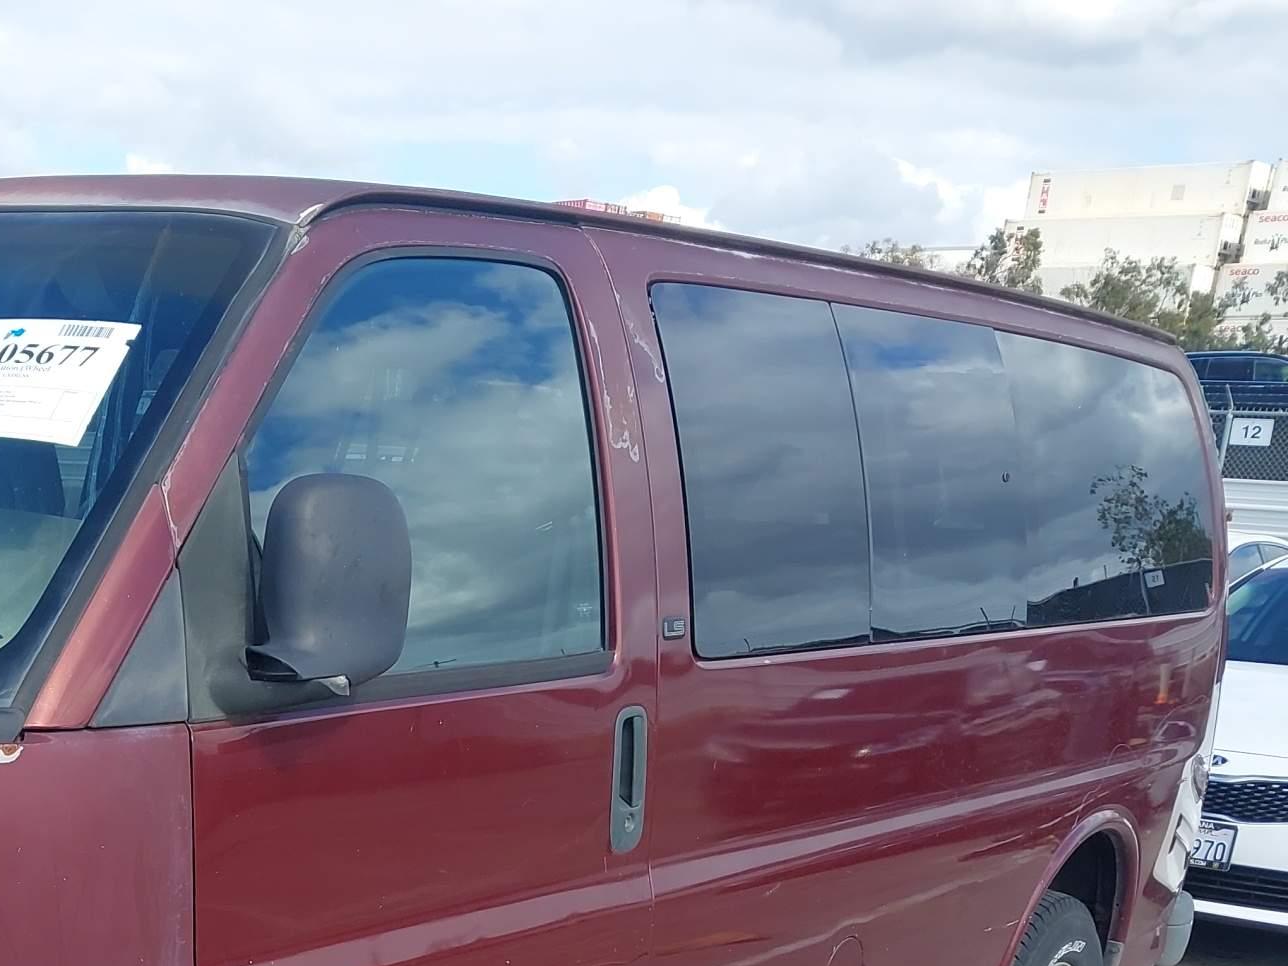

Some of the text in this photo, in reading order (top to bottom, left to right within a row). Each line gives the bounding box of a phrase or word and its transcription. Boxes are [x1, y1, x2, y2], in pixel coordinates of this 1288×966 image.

[1229, 268, 1260, 276] seaco
[1242, 424, 1262, 439] 12
[663, 620, 686, 637] LS
